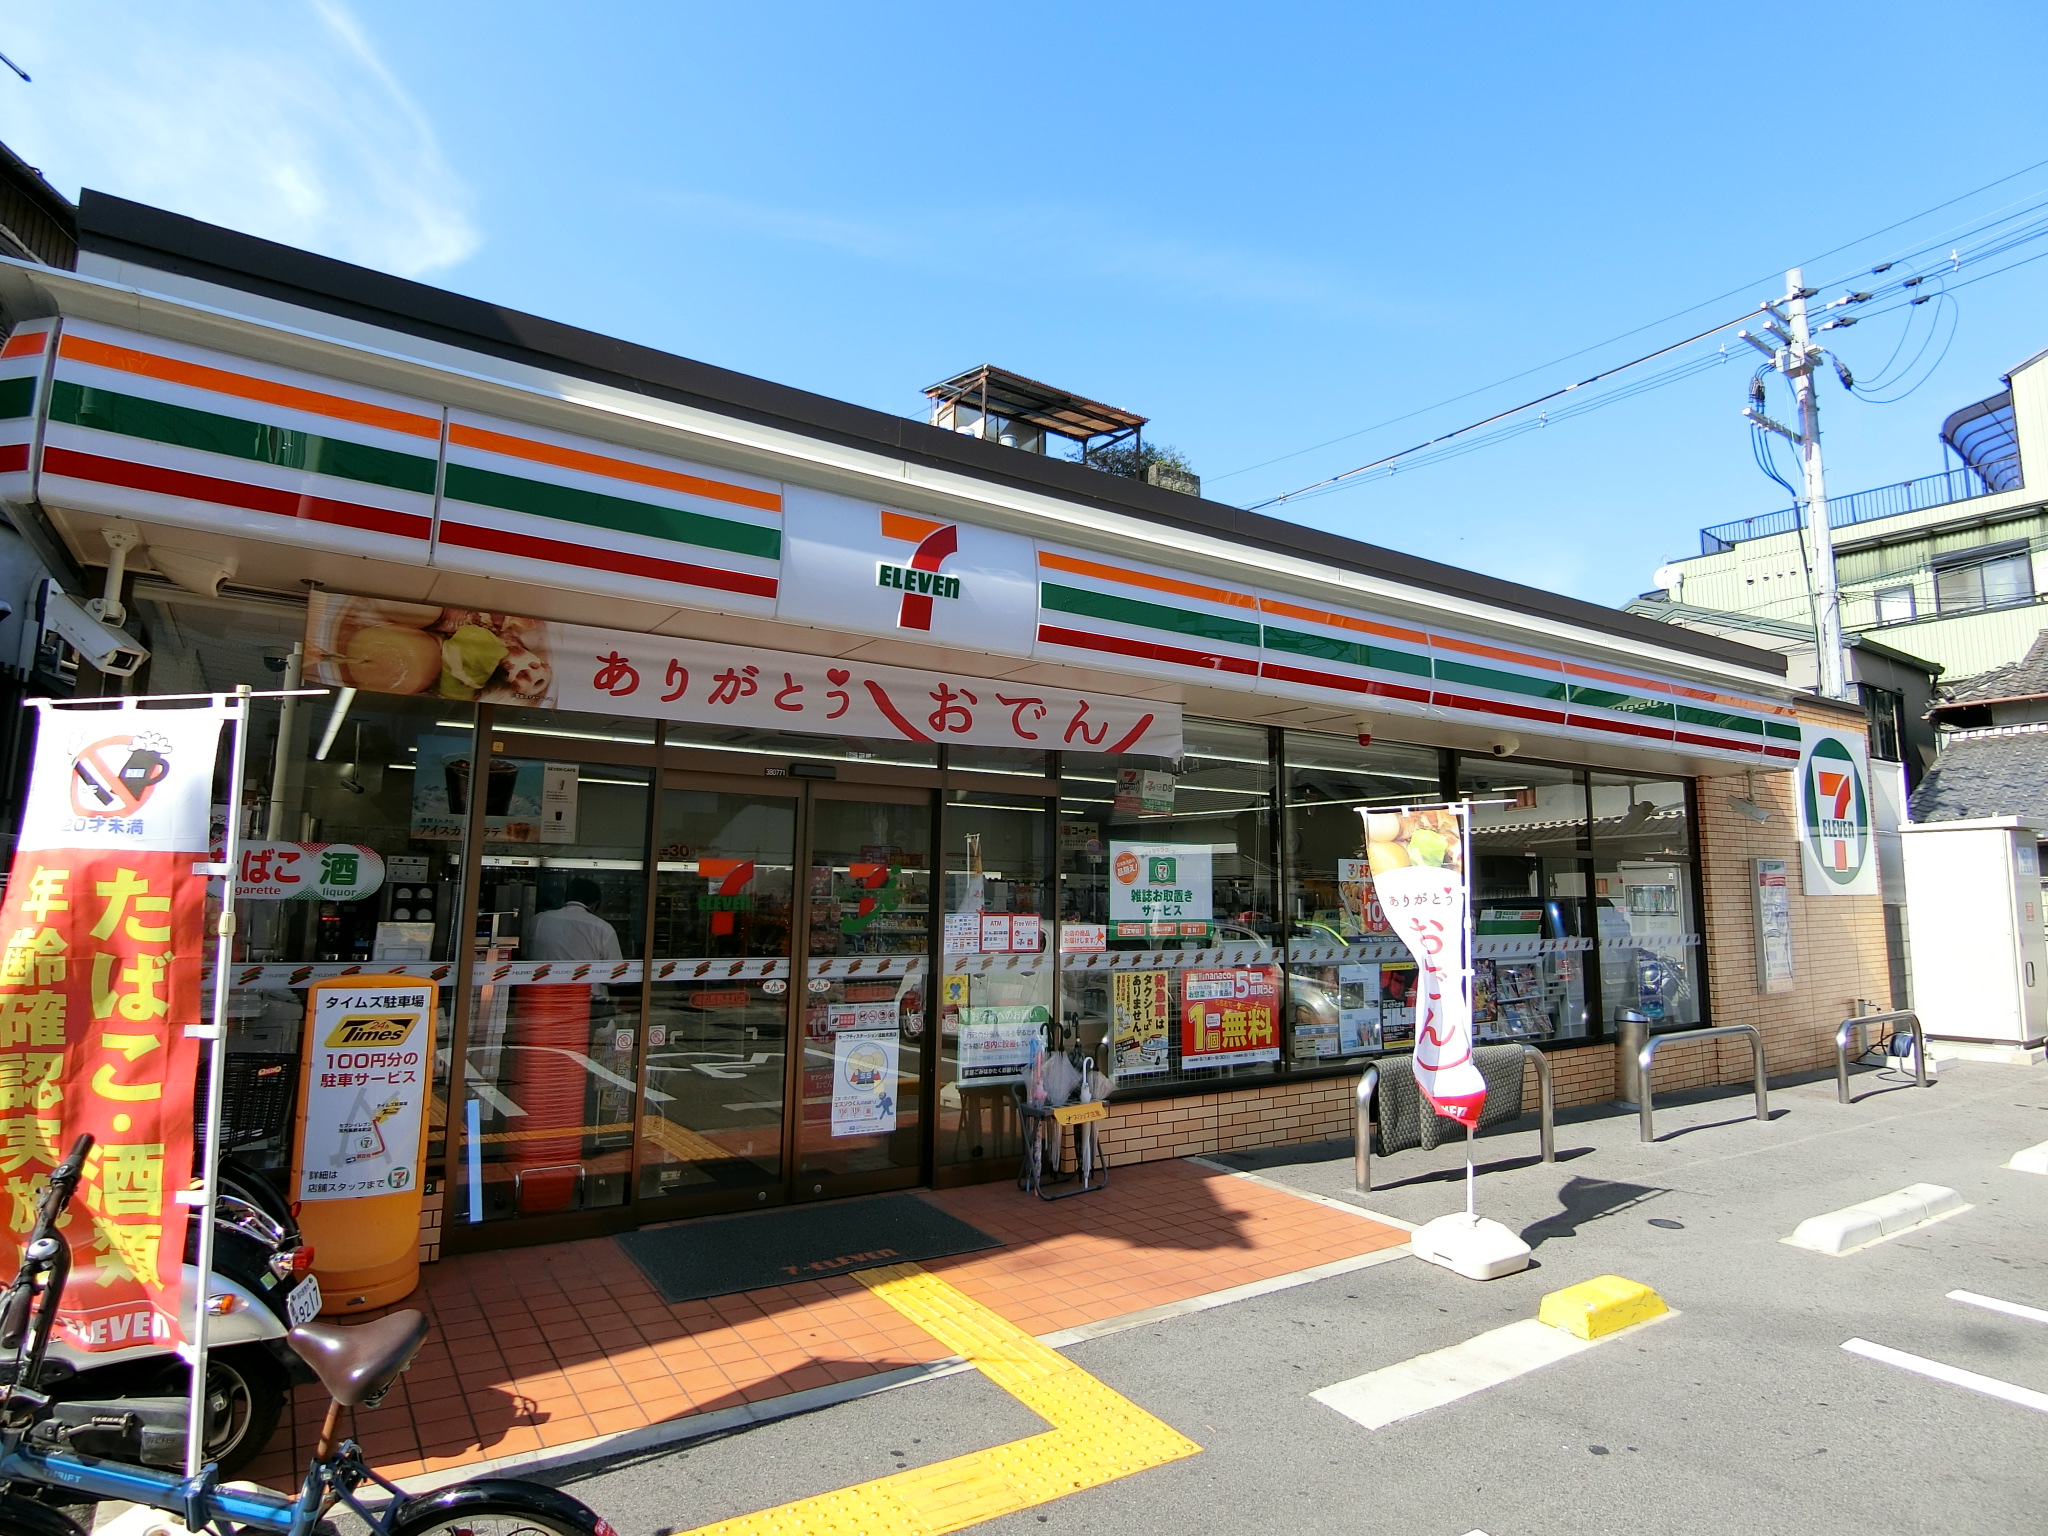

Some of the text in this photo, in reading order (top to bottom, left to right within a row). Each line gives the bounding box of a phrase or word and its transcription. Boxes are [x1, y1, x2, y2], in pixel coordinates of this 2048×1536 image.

[592, 650, 1109, 745] ありがとう おでん
[765, 768, 786, 776] 380771
[319, 851, 360, 886] 酒
[322, 887, 357, 898] liquor
[1131, 889, 1193, 903] 雑誌お取置き
[1389, 891, 1453, 908] ありがとう
[1142, 905, 1182, 916] サービス
[326, 995, 425, 1009] タイムズ駐車場
[1132, 974, 1142, 1037] ありません。
[1154, 973, 1167, 1030] 救急車は
[341, 1026, 404, 1043] Times
[326, 1052, 419, 1069] 100円分の
[82, 866, 176, 1291] たばこ・酒類
[320, 1070, 416, 1088] 駐車サービス
[309, 1170, 338, 1180] 詳細は
[307, 1179, 385, 1193] 店舗スタッフまで
[298, 1285, 320, 1323] 9217
